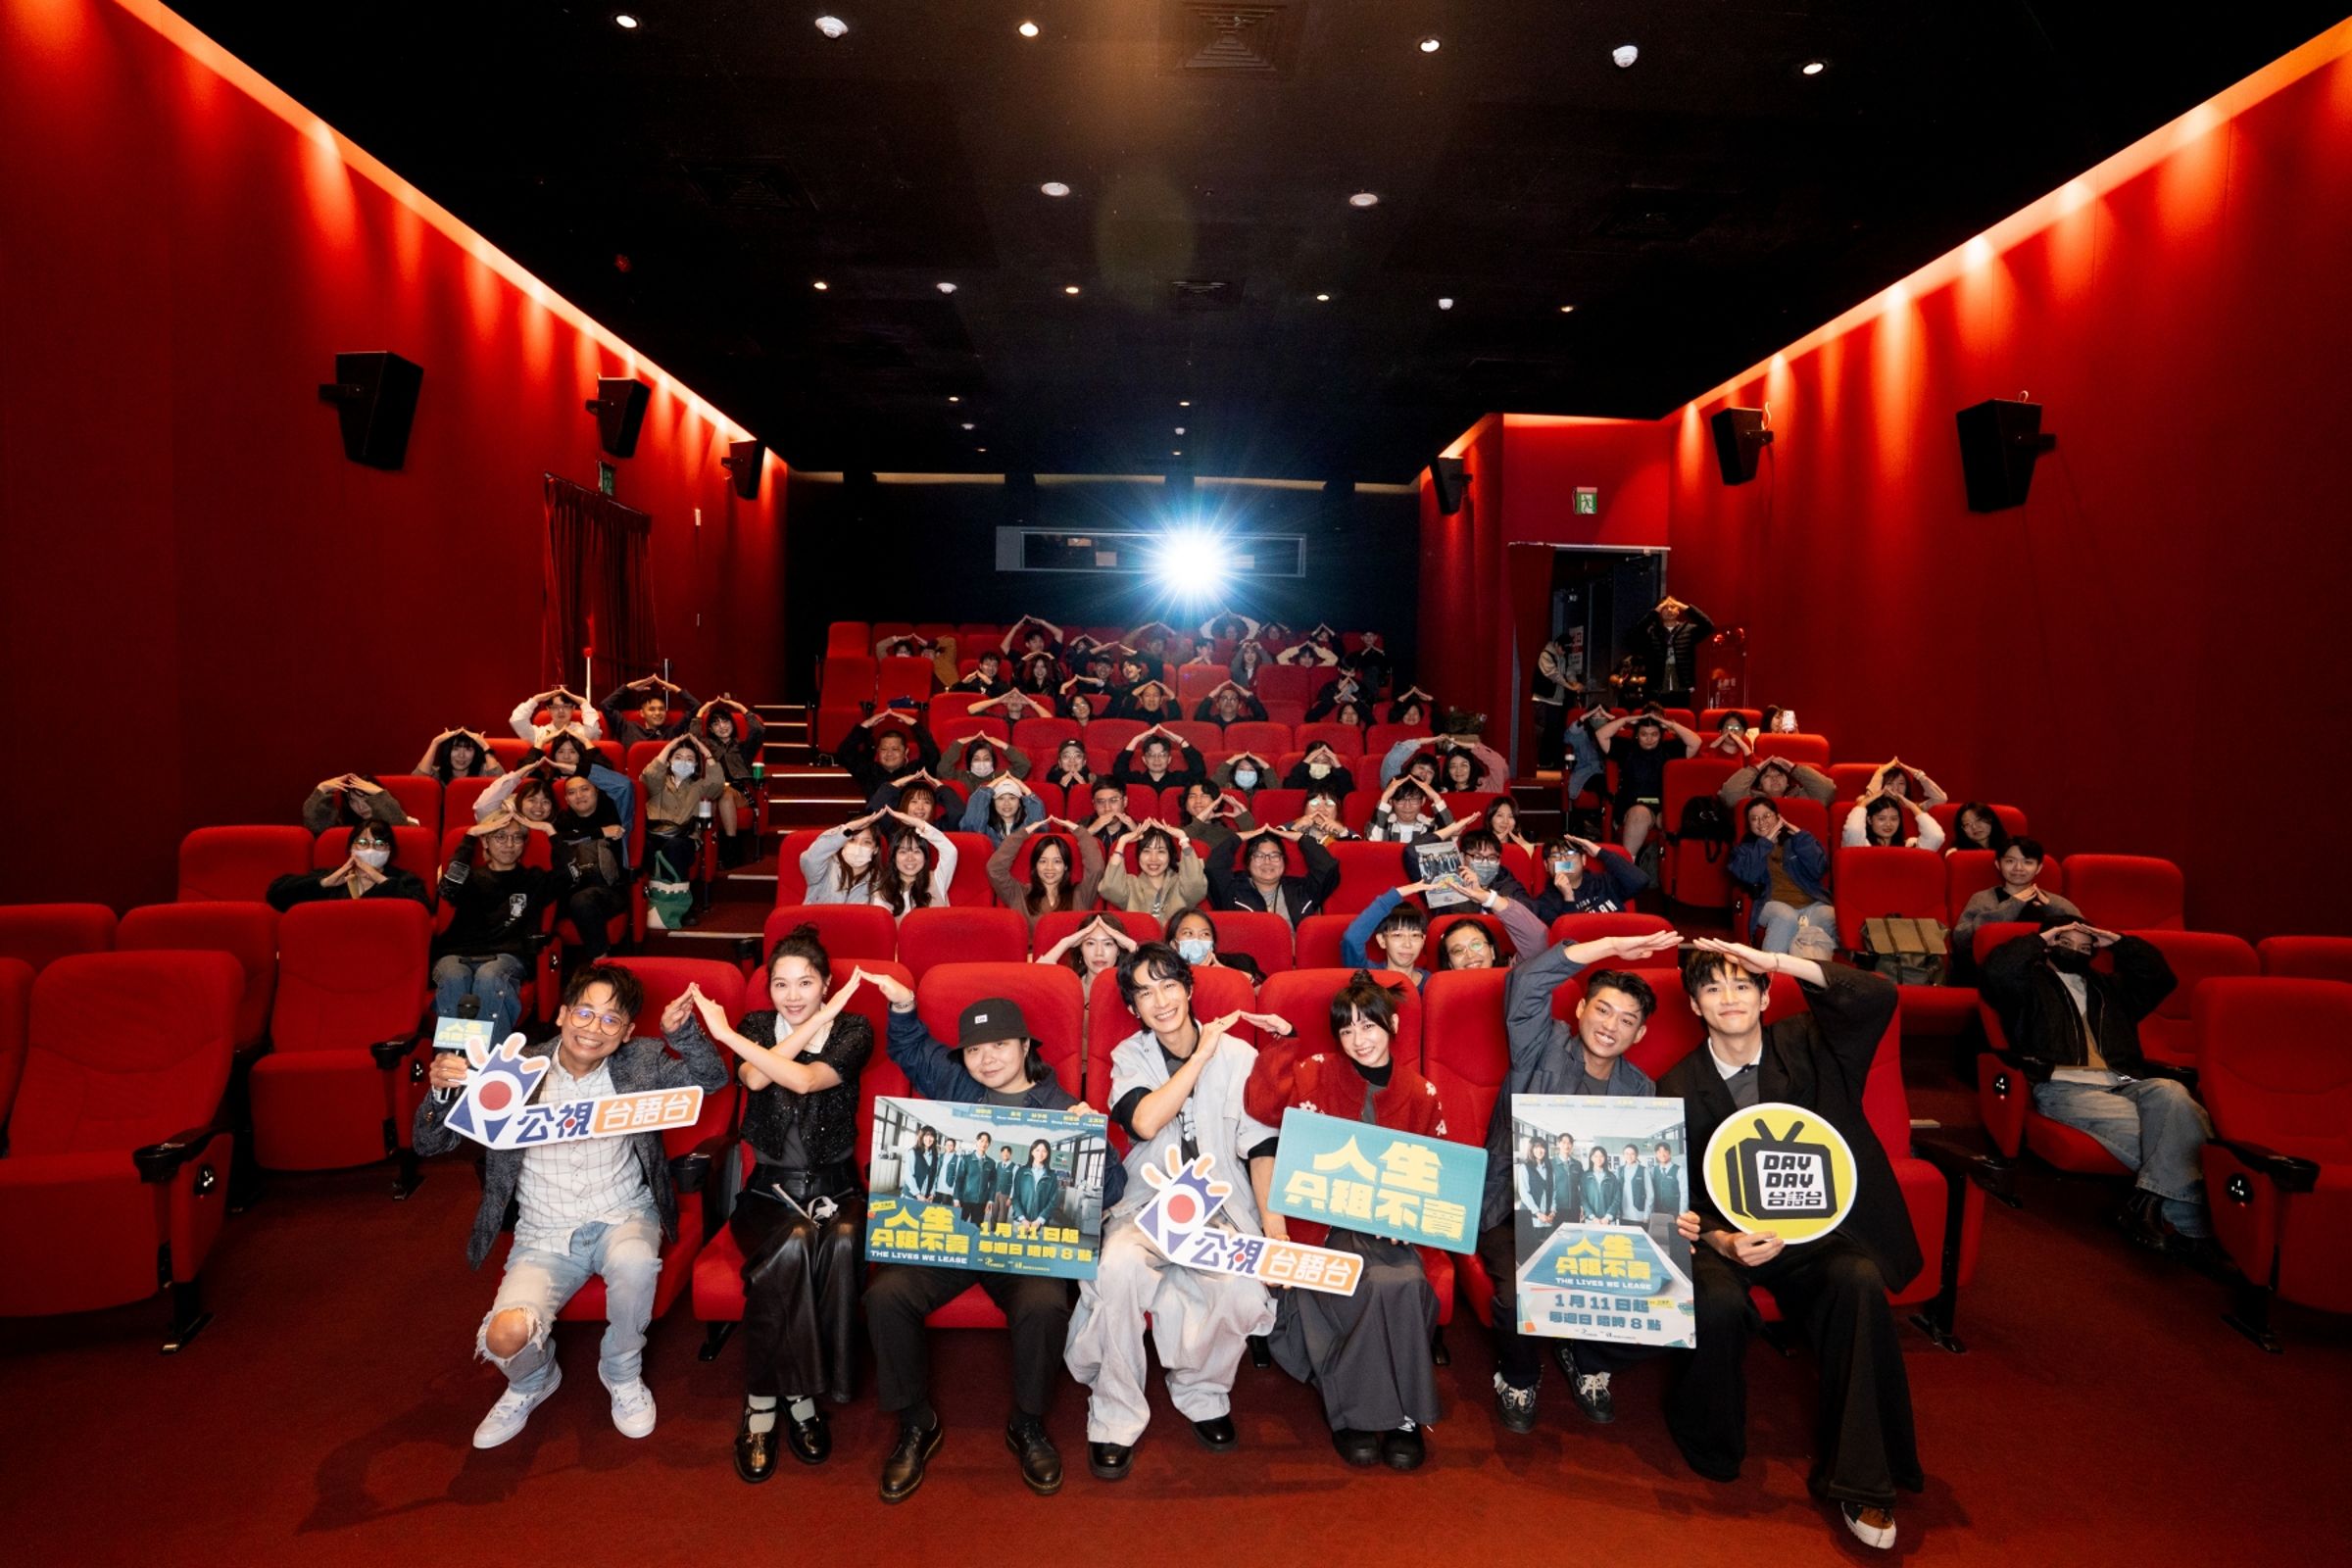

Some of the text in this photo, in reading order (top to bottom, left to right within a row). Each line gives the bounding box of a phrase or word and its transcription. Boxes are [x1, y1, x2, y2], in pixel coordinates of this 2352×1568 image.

[515, 1094, 692, 1144] 公視 台語台
[1312, 1134, 1443, 1196] 人生
[1284, 1169, 1466, 1242] 只租不賣
[1767, 1191, 1822, 1206] 台語台
[884, 1204, 956, 1234] 人生
[870, 1228, 970, 1254] 只租不賣
[1566, 1234, 1635, 1259] 人生
[891, 1251, 919, 1260] LIVES
[938, 1254, 967, 1264] LEASE
[1191, 1232, 1352, 1287] 公視 台語台
[1554, 1255, 1650, 1281] 只租不賣
[1622, 1282, 1652, 1291] LEASE
